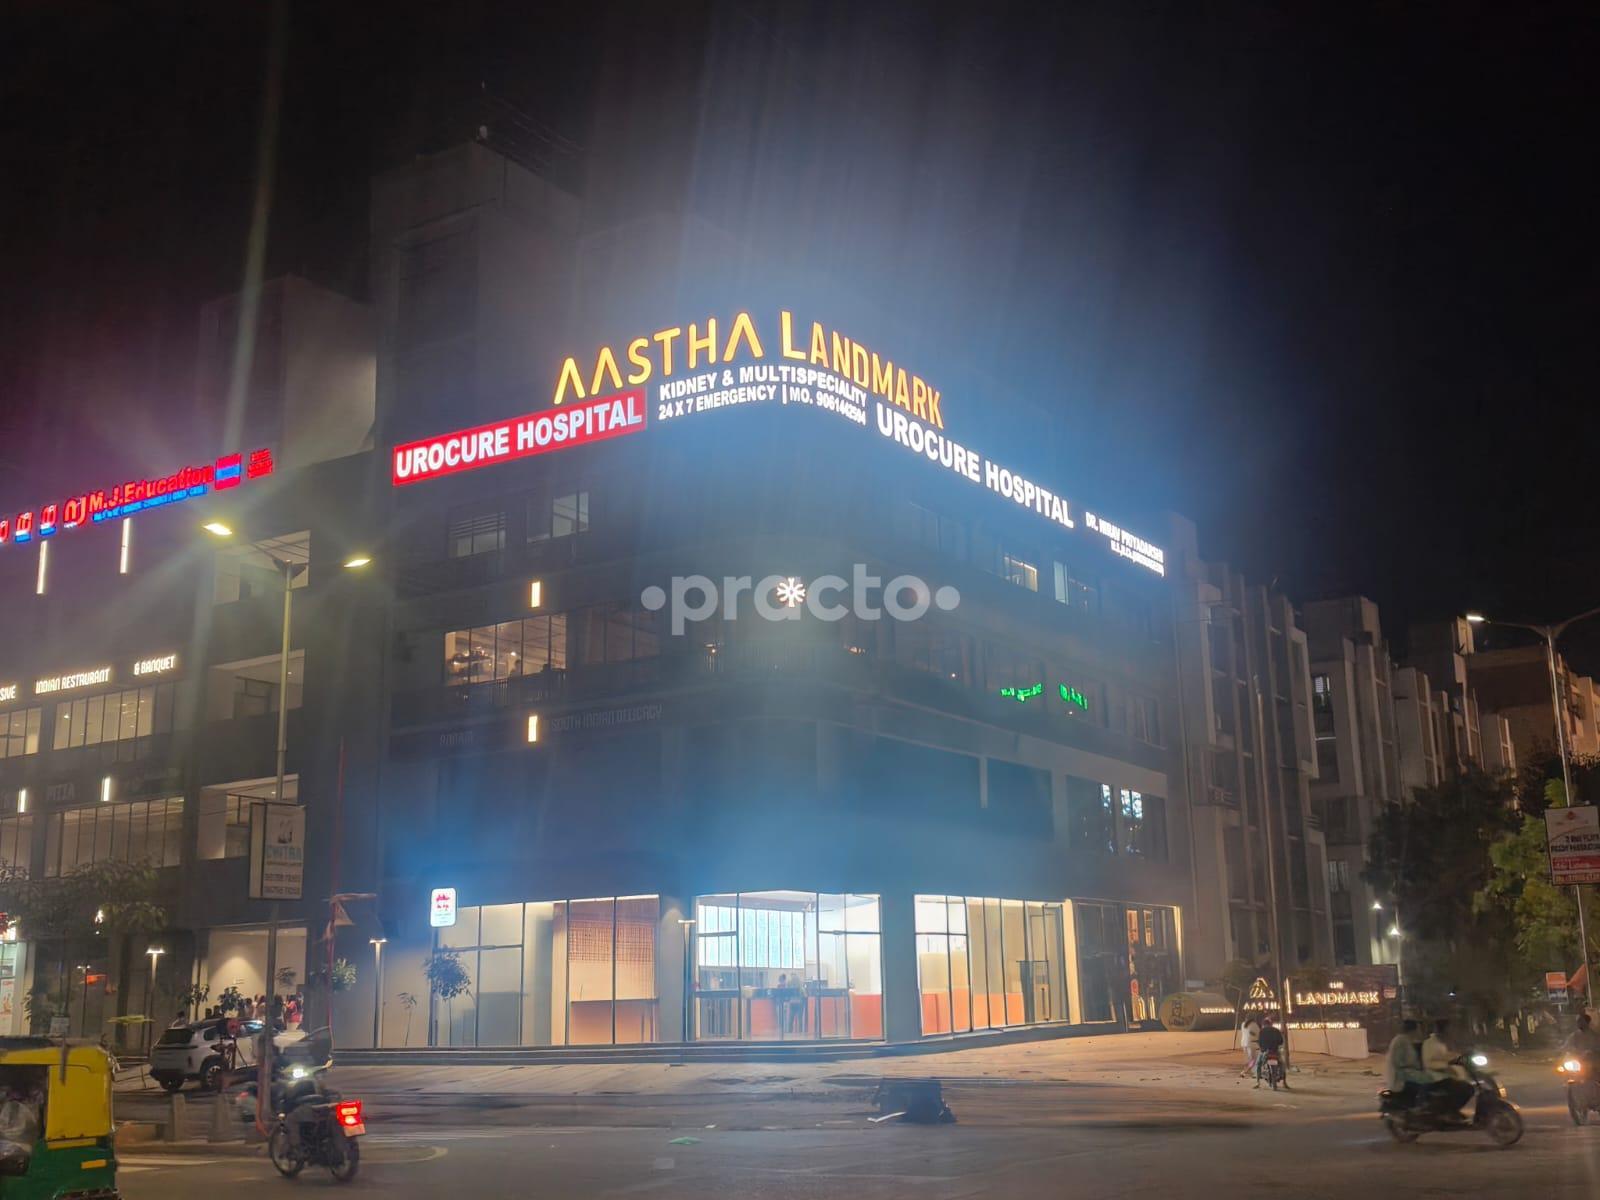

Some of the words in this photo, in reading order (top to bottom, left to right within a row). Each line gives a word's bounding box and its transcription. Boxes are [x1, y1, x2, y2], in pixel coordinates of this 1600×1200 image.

[553, 312, 764, 405] AASTHA
[781, 310, 944, 429] LANDMARK
[659, 372, 718, 401] KIDNEY
[722, 369, 734, 387] &
[739, 365, 867, 406] MULTISPECIALITY
[658, 404, 673, 421] 24
[675, 400, 684, 417] X
[686, 398, 694, 413] 7
[696, 384, 777, 413] EMERGENCY
[395, 426, 510, 478] UROCURE
[517, 396, 643, 451] HOSPITAL
[876, 402, 981, 484] UROCURE
[985, 459, 1075, 529] HOSPITAL
[141, 656, 176, 674] BANQUET
[1296, 991, 1380, 1005] LANDMARK
